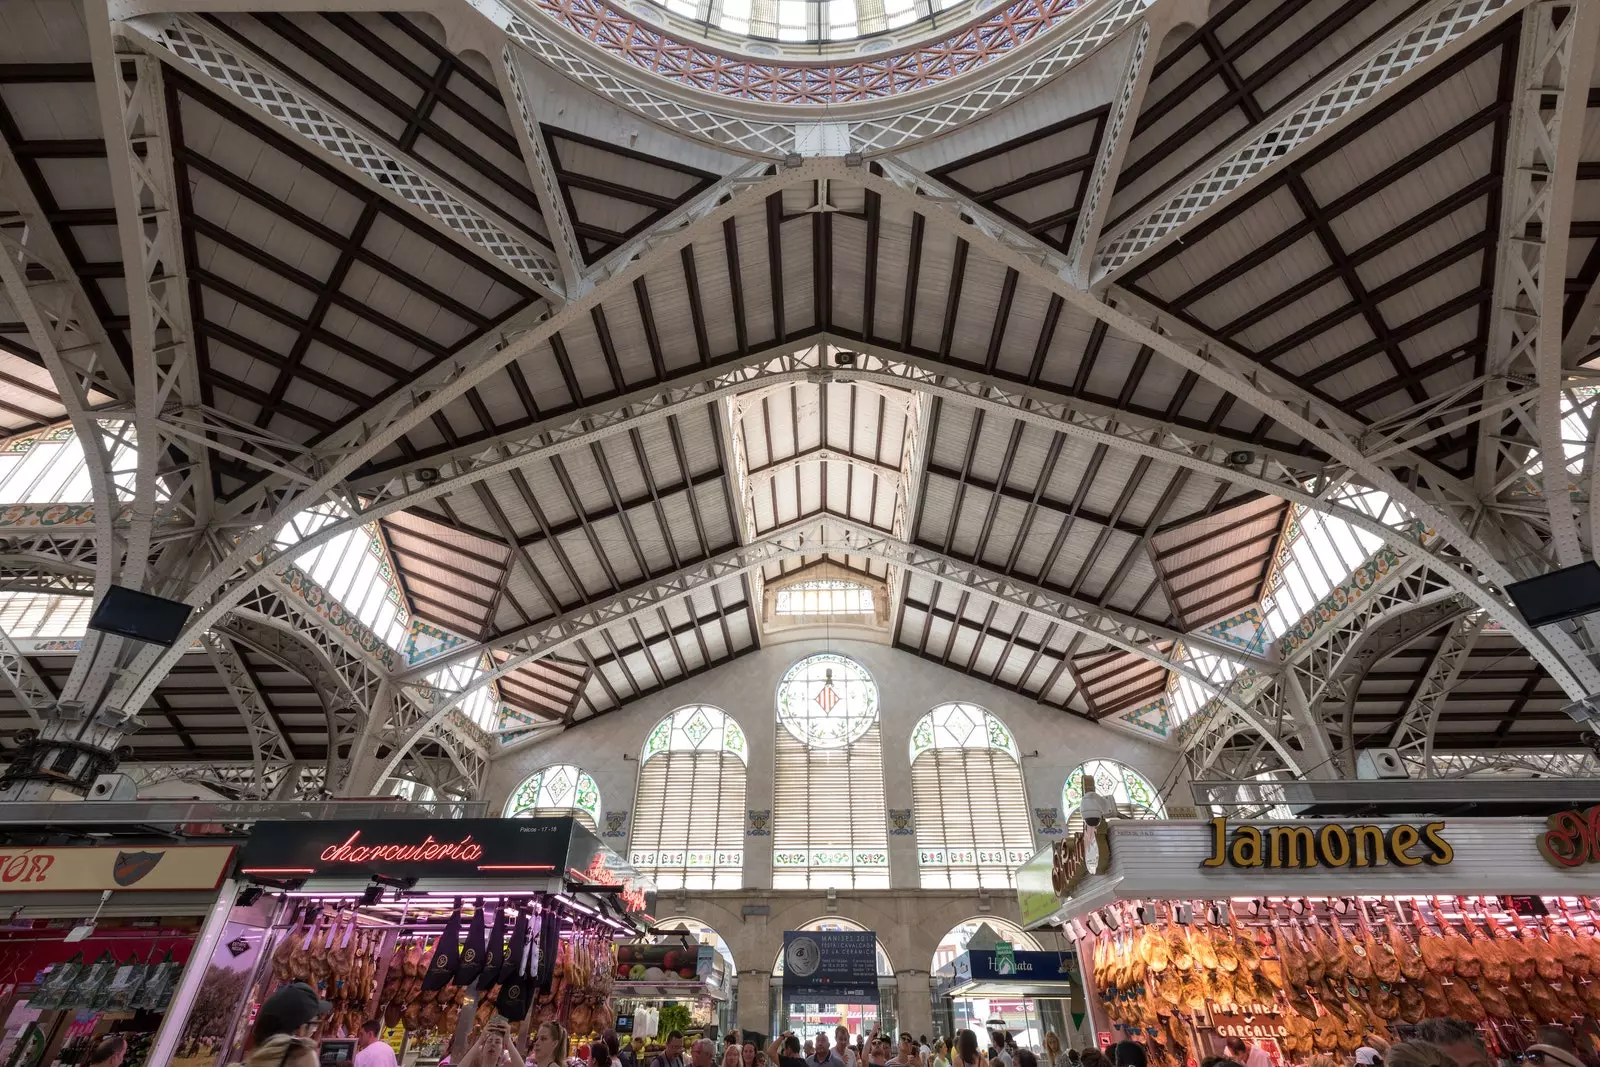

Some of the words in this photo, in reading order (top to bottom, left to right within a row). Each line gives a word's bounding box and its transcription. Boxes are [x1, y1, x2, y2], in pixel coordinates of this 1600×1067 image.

[320, 830, 482, 862] charcutería
[1200, 816, 1454, 869] Jamones
[1217, 1024, 1288, 1037] GARGALLO
